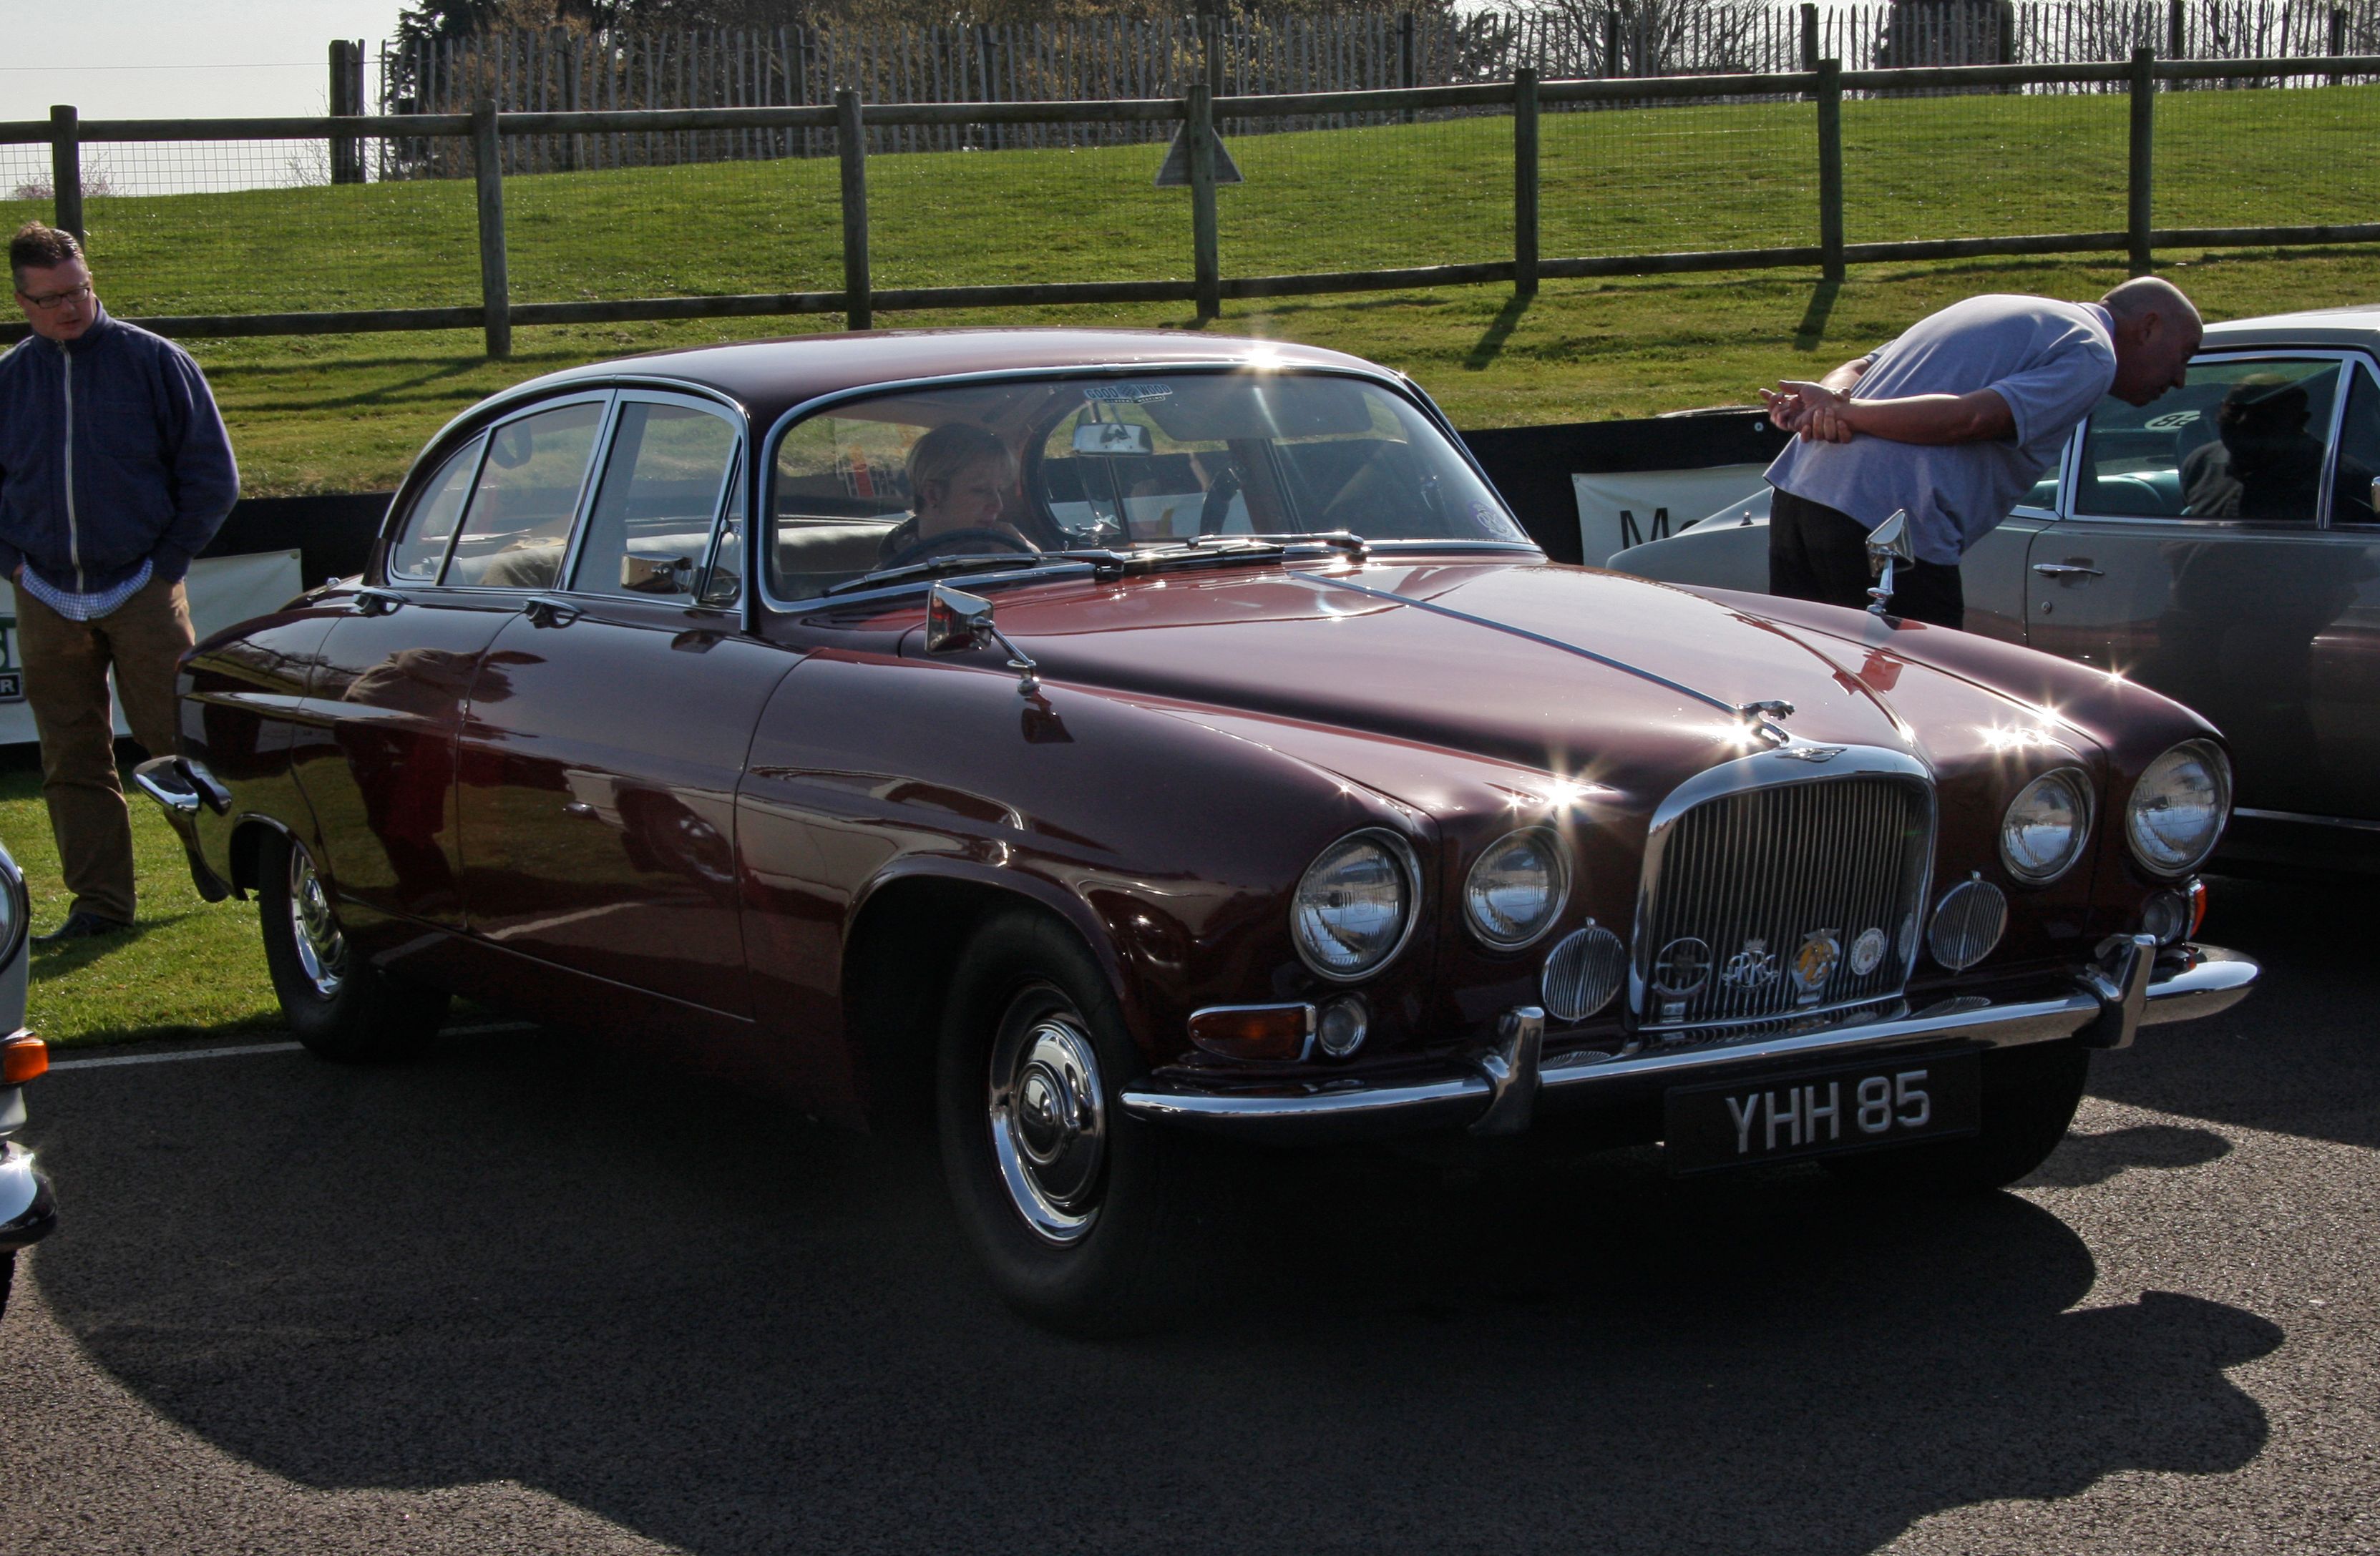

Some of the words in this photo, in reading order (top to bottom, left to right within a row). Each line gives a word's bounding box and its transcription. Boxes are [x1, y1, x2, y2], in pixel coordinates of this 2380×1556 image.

[1086, 387, 1118, 398] GOOD
[1136, 384, 1170, 396] WOOD
[1725, 1082, 1840, 1153] YHH
[1857, 1070, 1931, 1134] 85
